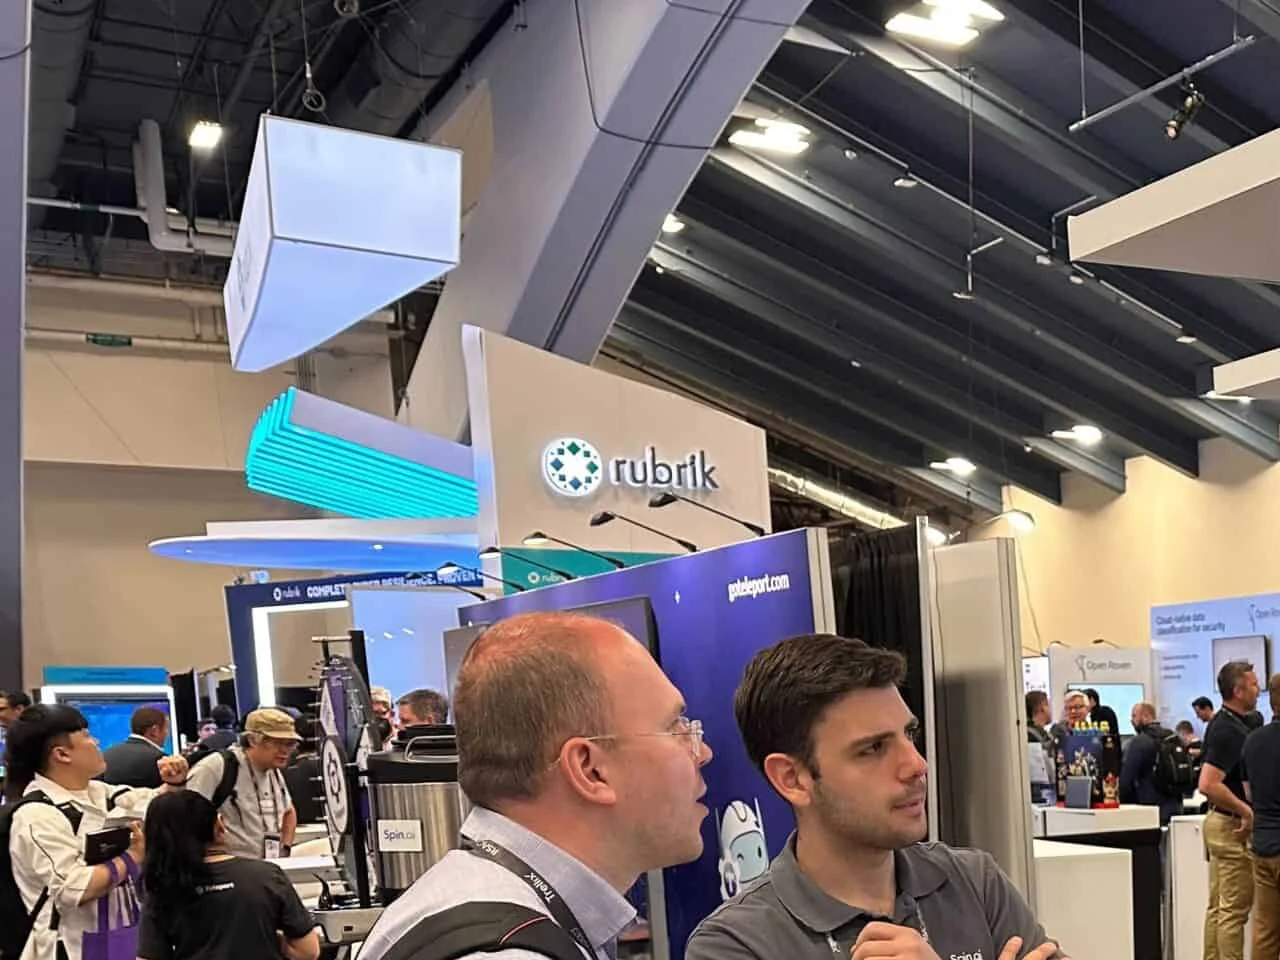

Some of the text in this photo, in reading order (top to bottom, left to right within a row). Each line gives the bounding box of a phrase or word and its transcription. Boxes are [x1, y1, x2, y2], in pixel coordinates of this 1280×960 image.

[610, 446, 719, 489] rubrik
[307, 583, 347, 598] COMPLET
[728, 573, 789, 602] goteleport.com
[524, 871, 555, 901] Trellix
